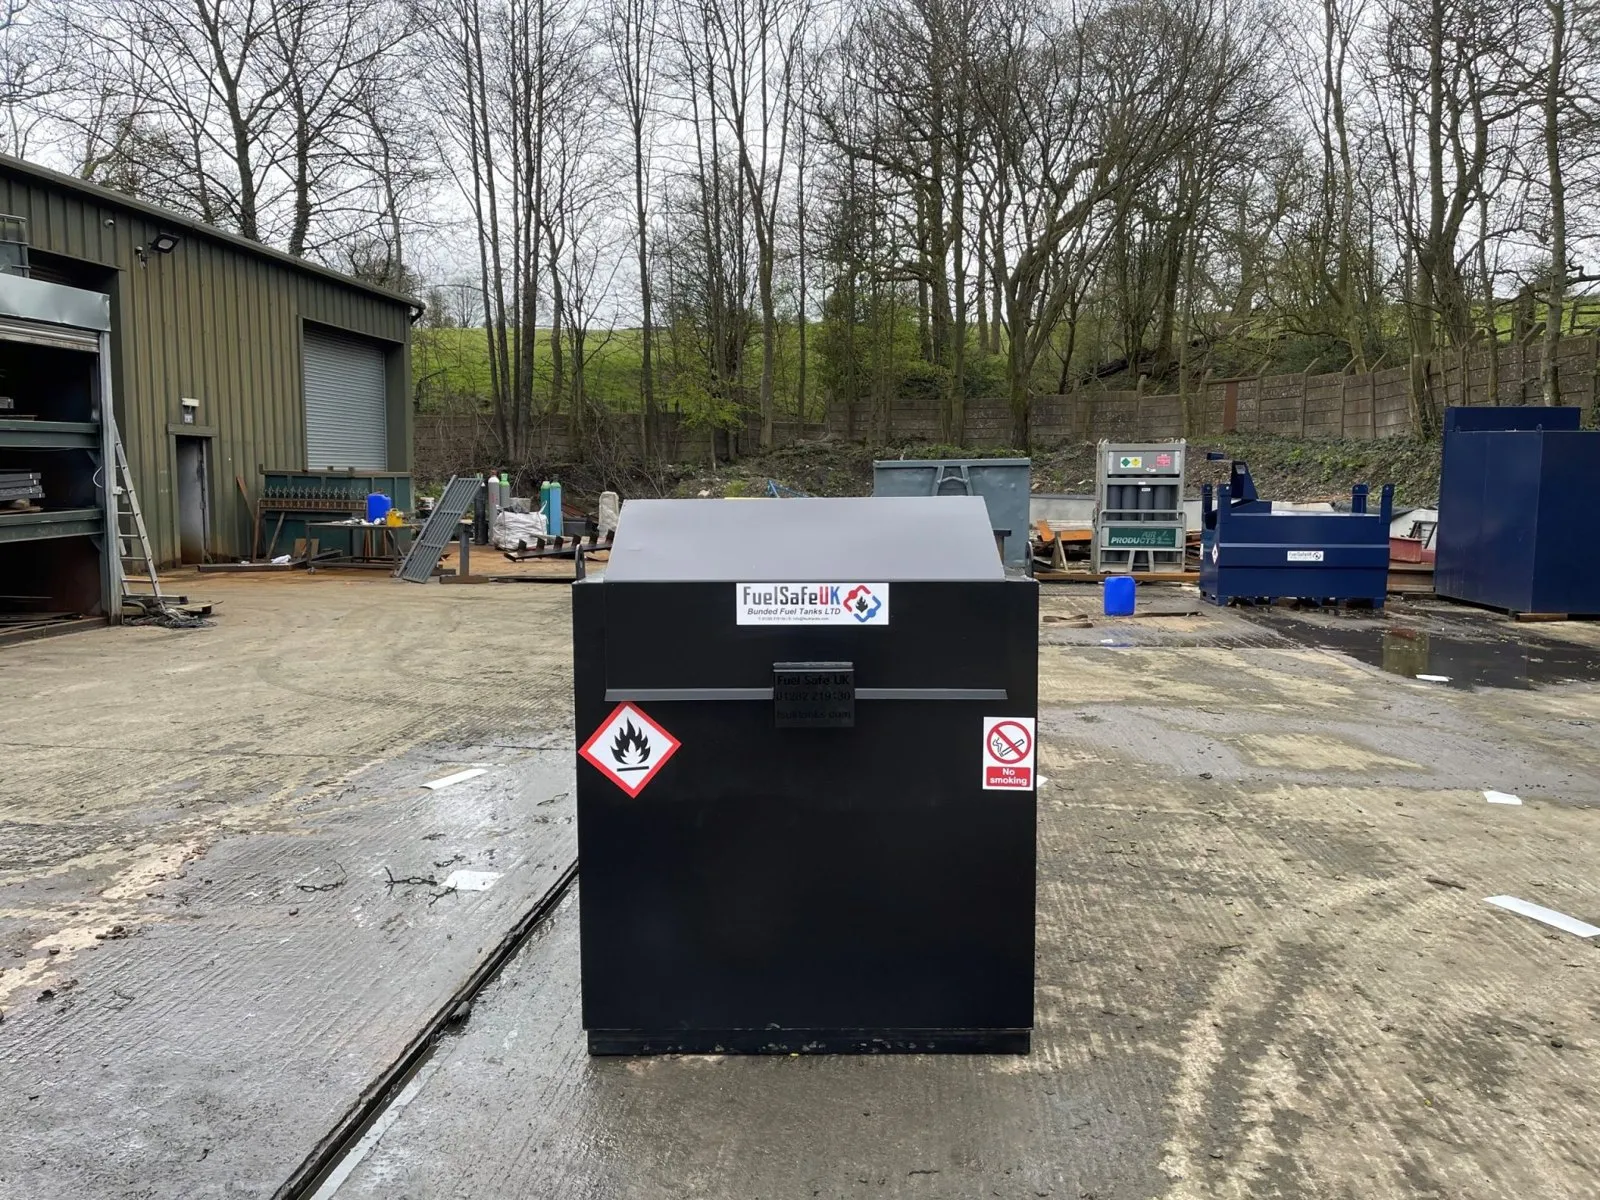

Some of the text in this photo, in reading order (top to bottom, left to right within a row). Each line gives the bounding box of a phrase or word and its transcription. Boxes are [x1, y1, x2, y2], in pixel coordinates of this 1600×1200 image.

[743, 586, 841, 605] FuelSafeUK
[747, 607, 841, 615] Bunded Fuel Tanks LTD
[777, 675, 850, 685] Fuel Safe UK
[1002, 768, 1015, 776] No
[990, 777, 1028, 786] smoking
